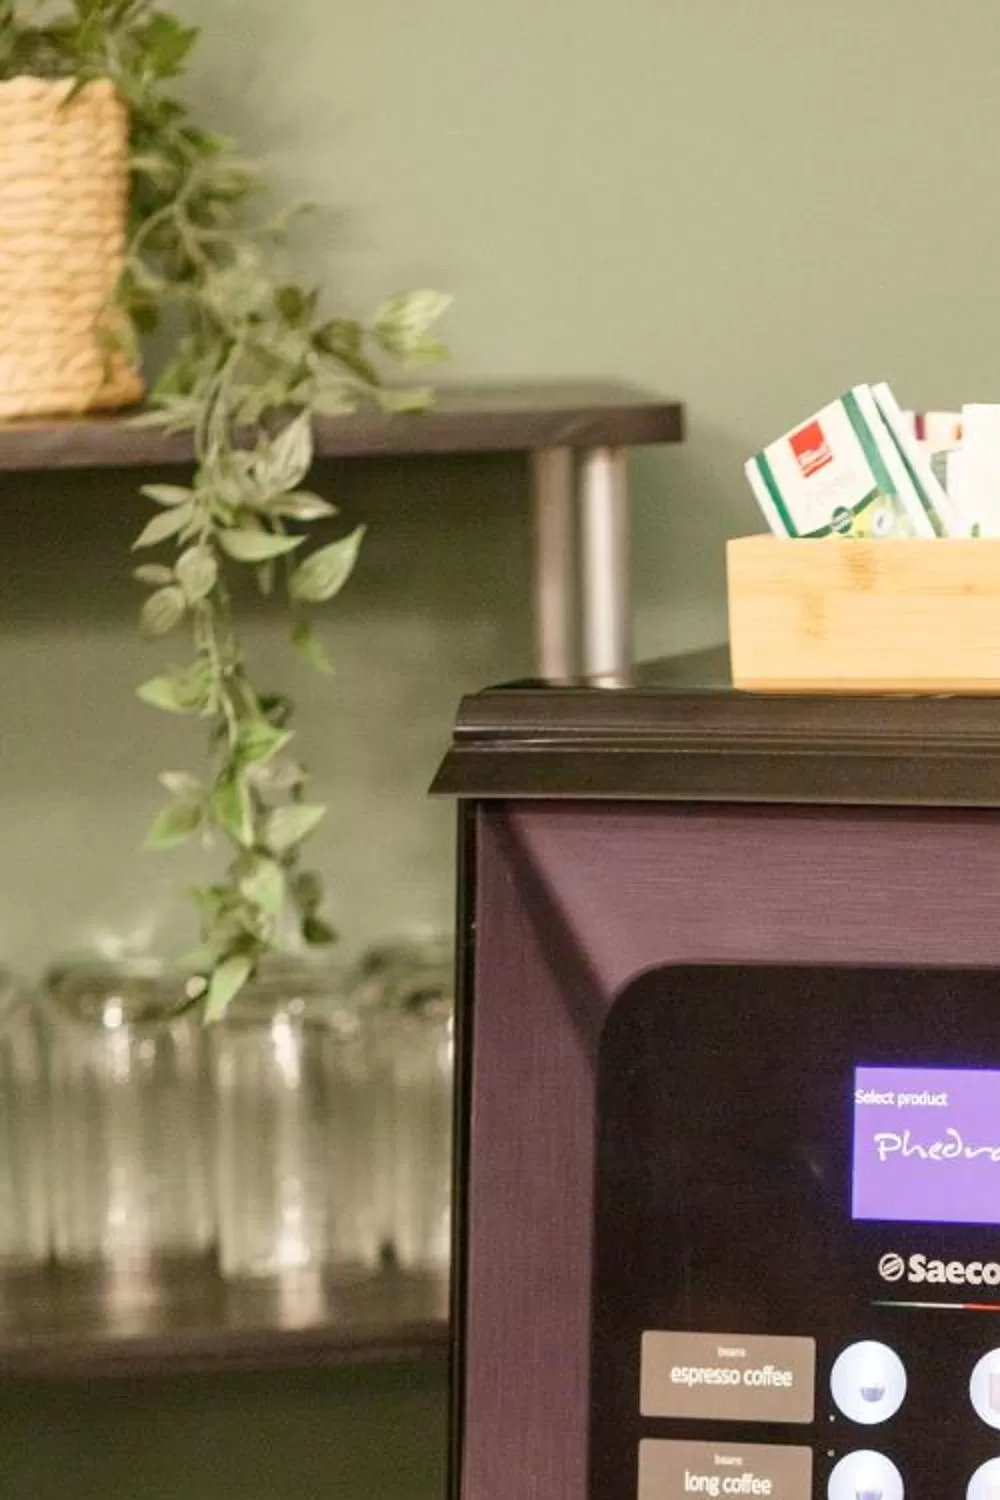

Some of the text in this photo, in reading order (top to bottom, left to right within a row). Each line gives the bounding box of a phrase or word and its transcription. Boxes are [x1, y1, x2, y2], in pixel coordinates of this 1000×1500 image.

[855, 1089, 948, 1108] Select product
[670, 1365, 793, 1388] espresso coffee
[684, 1469, 772, 1497] long coffee
